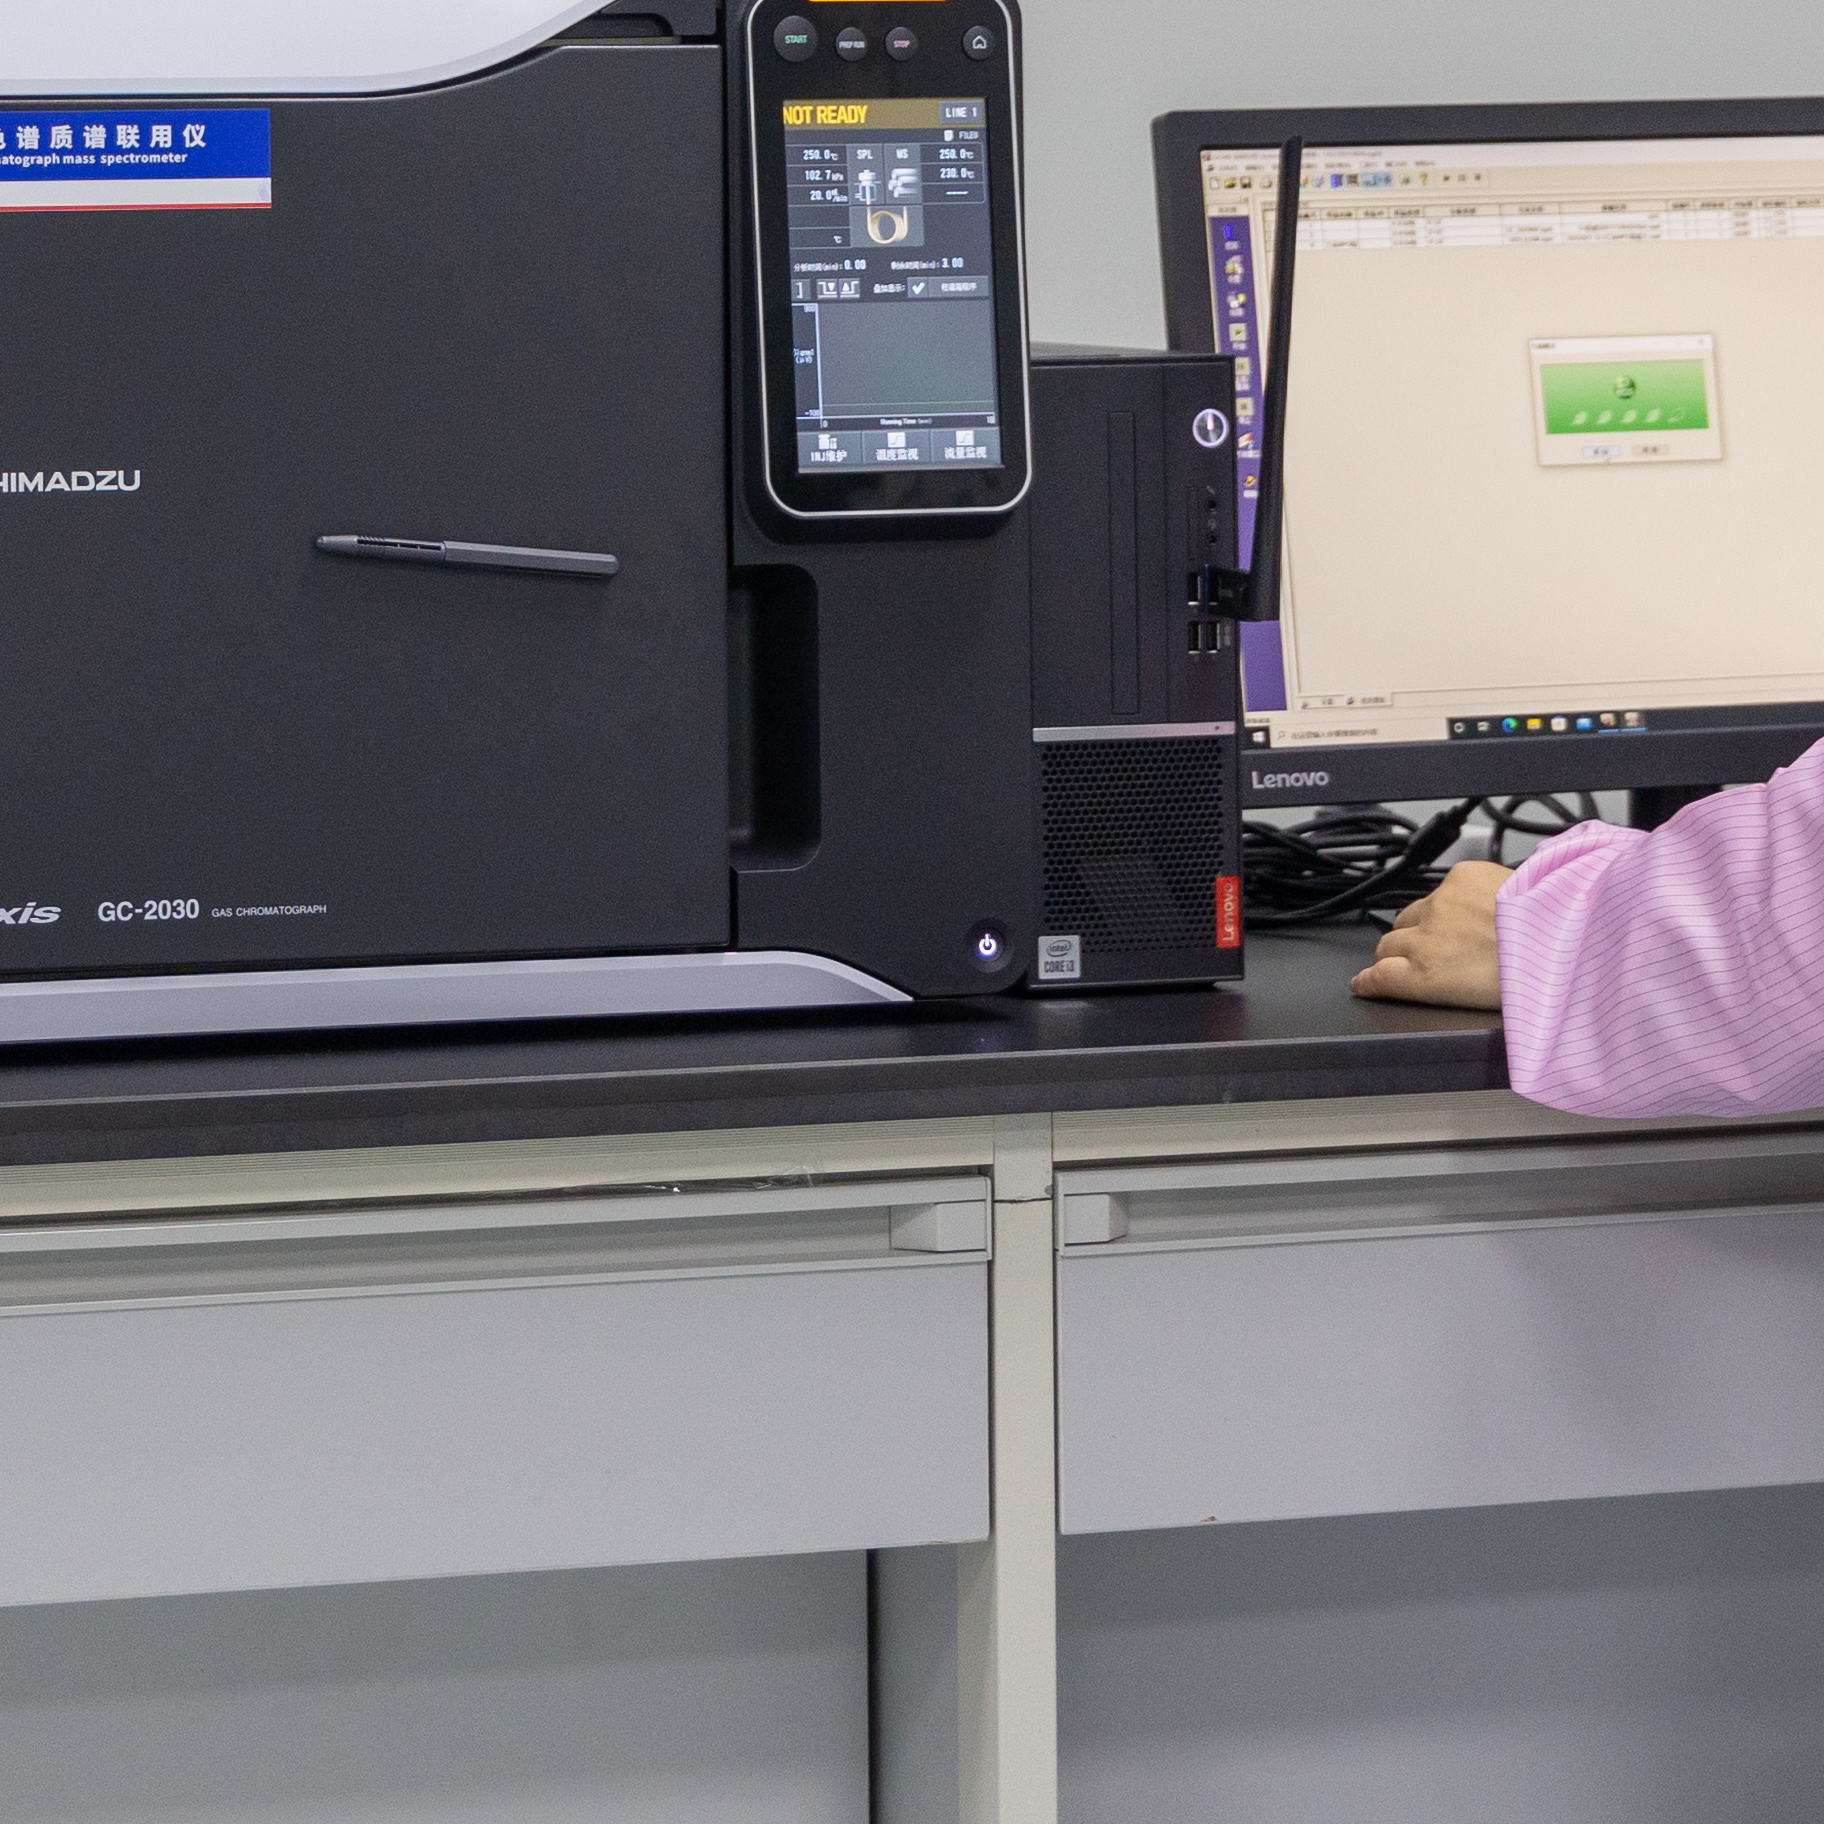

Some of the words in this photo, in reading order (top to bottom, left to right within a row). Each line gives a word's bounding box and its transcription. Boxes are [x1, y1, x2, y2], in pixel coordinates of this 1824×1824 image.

[785, 35, 808, 44] START
[782, 106, 814, 124] NOT
[817, 105, 868, 124] READY
[945, 107, 967, 118] LINE
[972, 107, 977, 117] 1
[63, 154, 96, 165] mass
[100, 152, 188, 166] spectrometer
[857, 149, 874, 160] SPL
[1251, 770, 1330, 790] Lenovo
[97, 898, 200, 923] GC-2030
[211, 907, 232, 918] GAS
[236, 904, 327, 917] CHROMATOGRAPH
[1222, 883, 1235, 942] Lenovo
[1049, 943, 1069, 953] intel
[1043, 961, 1065, 973] CORE
[1066, 960, 1075, 972] i3
